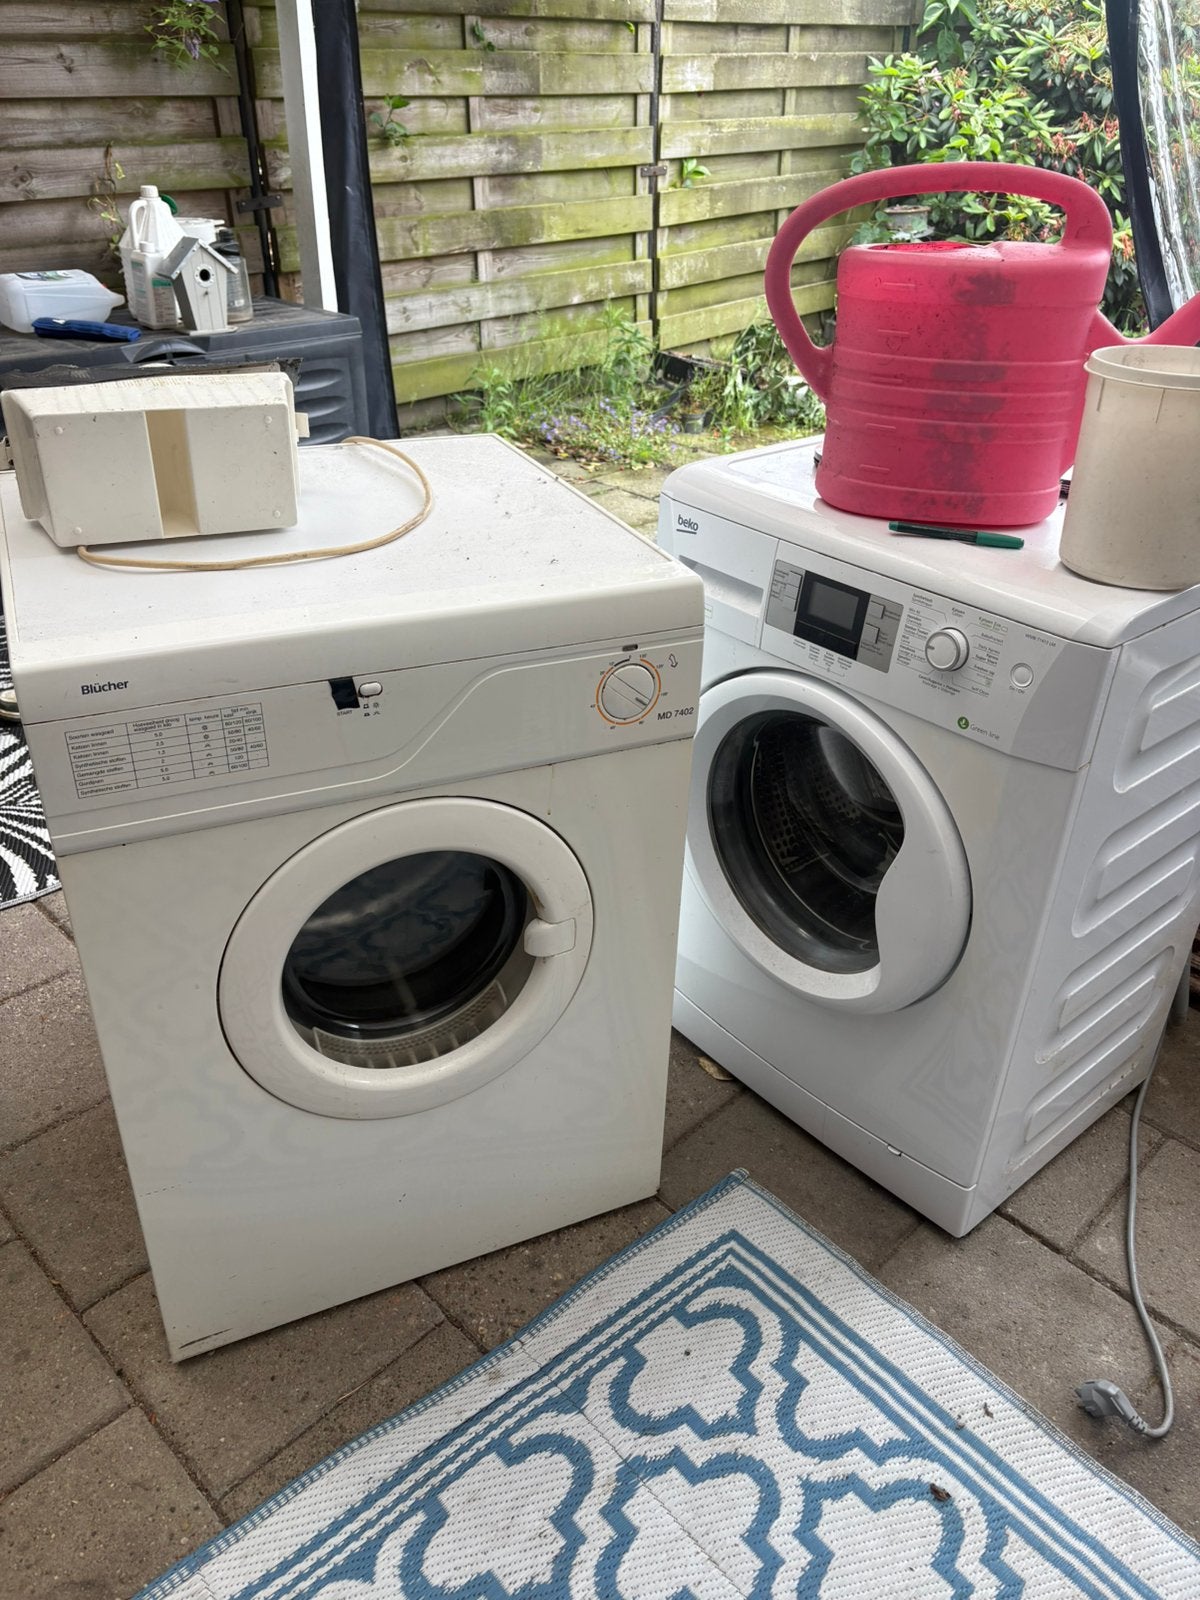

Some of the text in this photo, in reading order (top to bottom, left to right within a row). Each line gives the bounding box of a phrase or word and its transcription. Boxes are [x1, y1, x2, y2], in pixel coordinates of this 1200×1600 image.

[678, 514, 698, 532] beko
[80, 680, 128, 695] Blücher
[657, 707, 694, 720] MD 7402
[970, 723, 988, 736] Green
